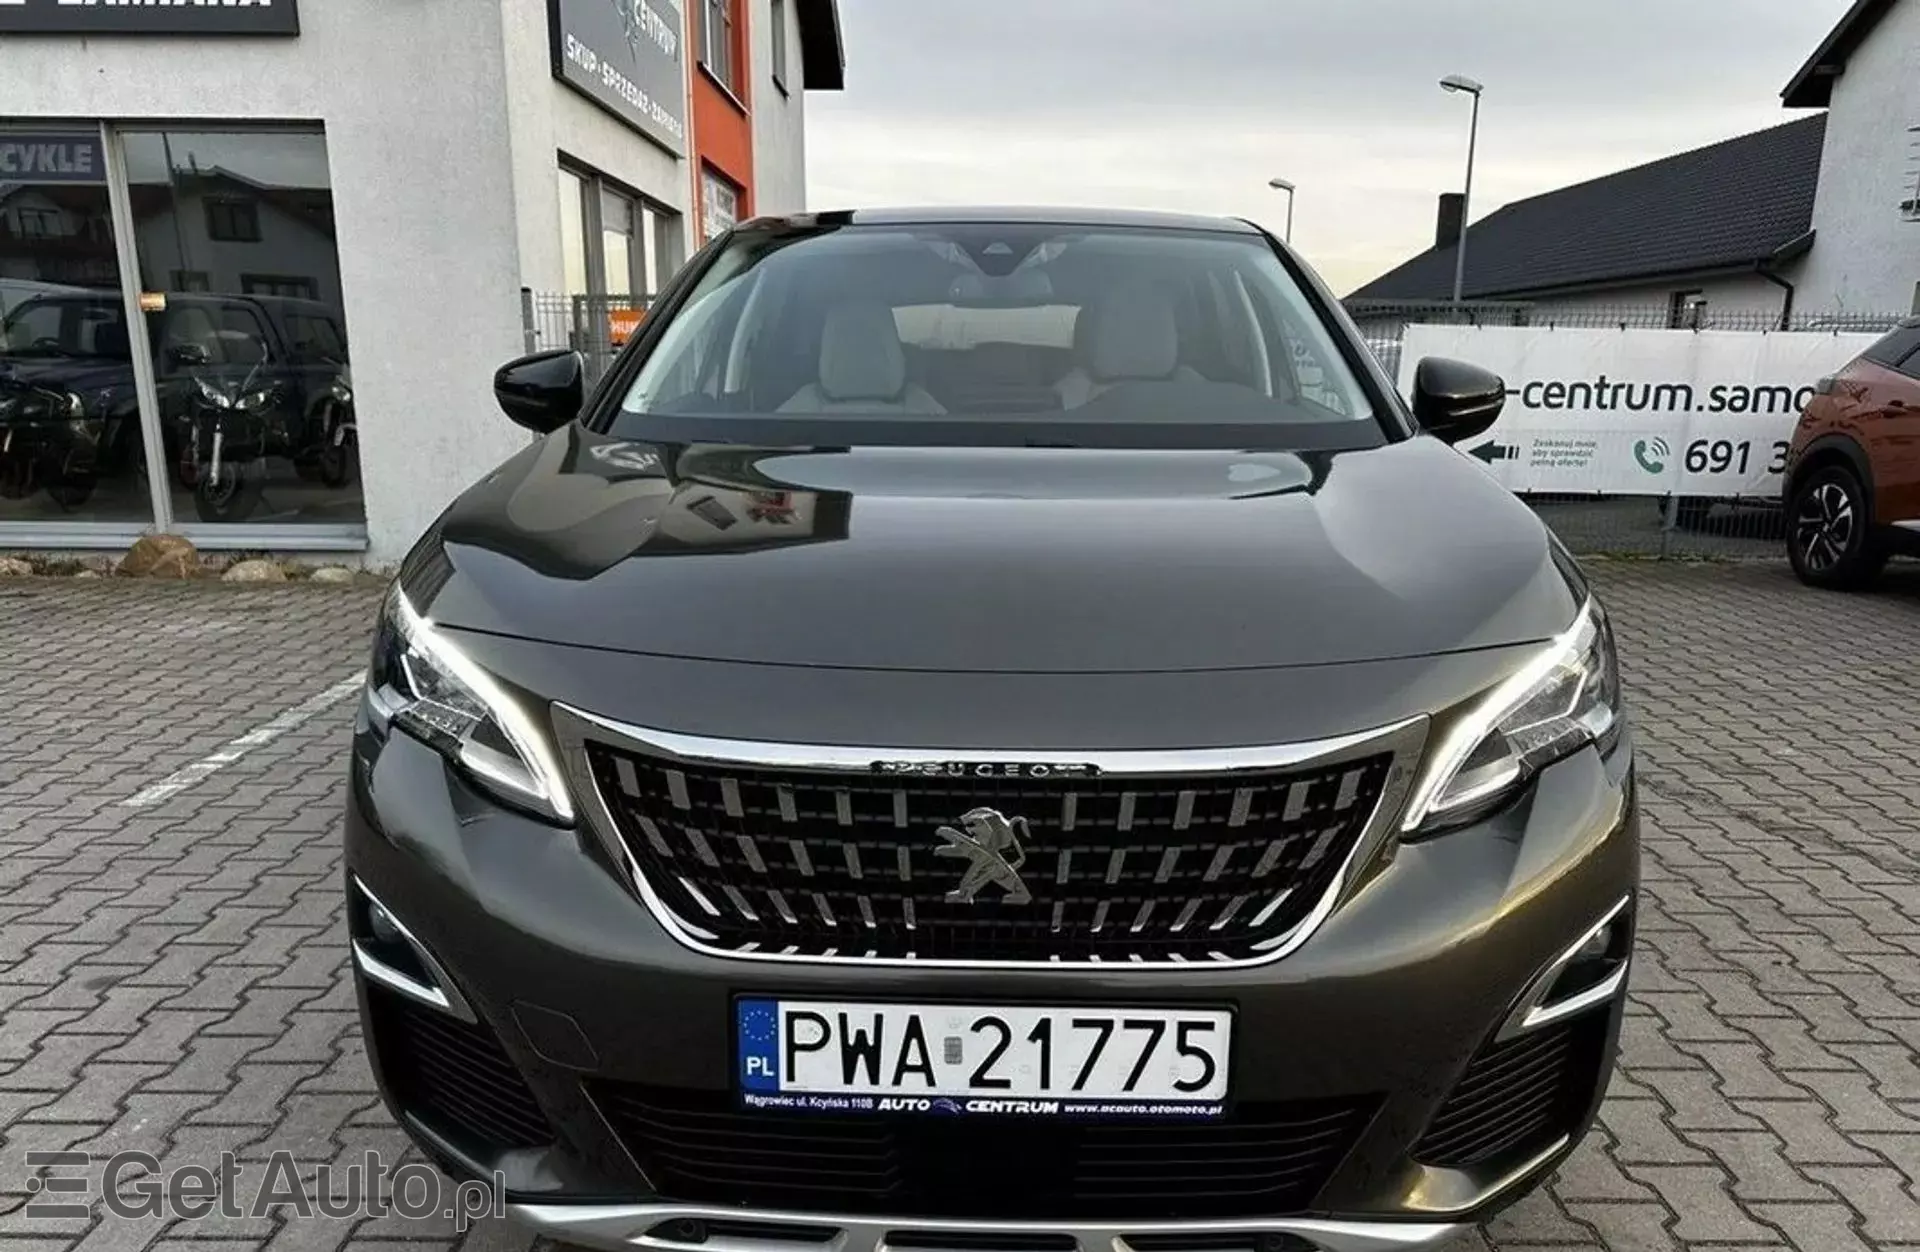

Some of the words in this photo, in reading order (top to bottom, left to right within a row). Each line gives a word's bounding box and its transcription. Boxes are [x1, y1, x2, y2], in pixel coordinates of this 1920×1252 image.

[567, 33, 597, 73] SKUP
[0, 143, 92, 173] CYKLE
[1684, 439, 1751, 474] 691
[1767, 441, 1790, 474] 3
[746, 1056, 775, 1077] PL
[785, 1010, 937, 1088] PWA
[969, 1015, 1216, 1093] 21775
[877, 1098, 931, 1111] AUTO
[965, 1099, 1059, 1114] CENTRUM
[1063, 1104, 1223, 1116] www.acauto.otomoto.pl
